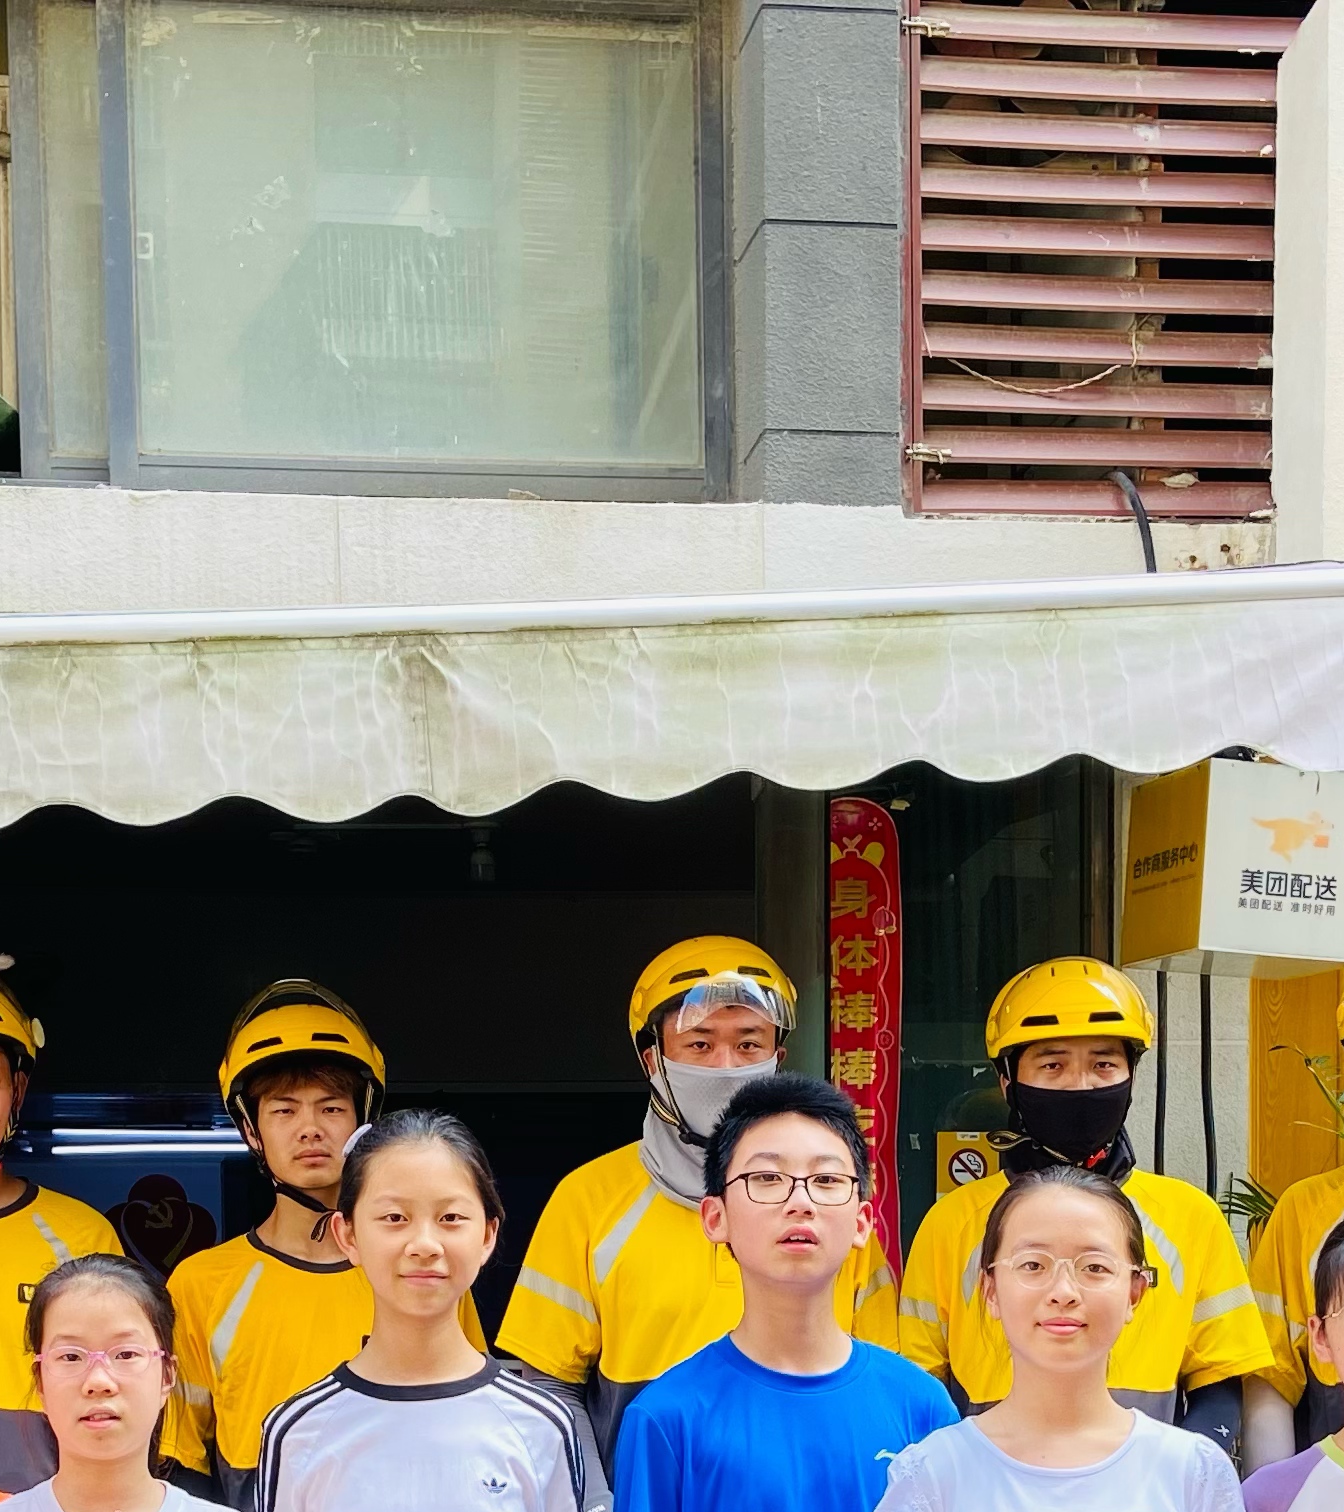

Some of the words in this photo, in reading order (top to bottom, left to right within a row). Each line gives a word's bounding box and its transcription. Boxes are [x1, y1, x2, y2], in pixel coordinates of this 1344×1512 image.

[1239, 868, 1337, 901] 美团配送
[1237, 896, 1283, 912] 美团配送
[1290, 901, 1336, 917] 准时好用
[830, 878, 878, 1147] 身体棒棒
